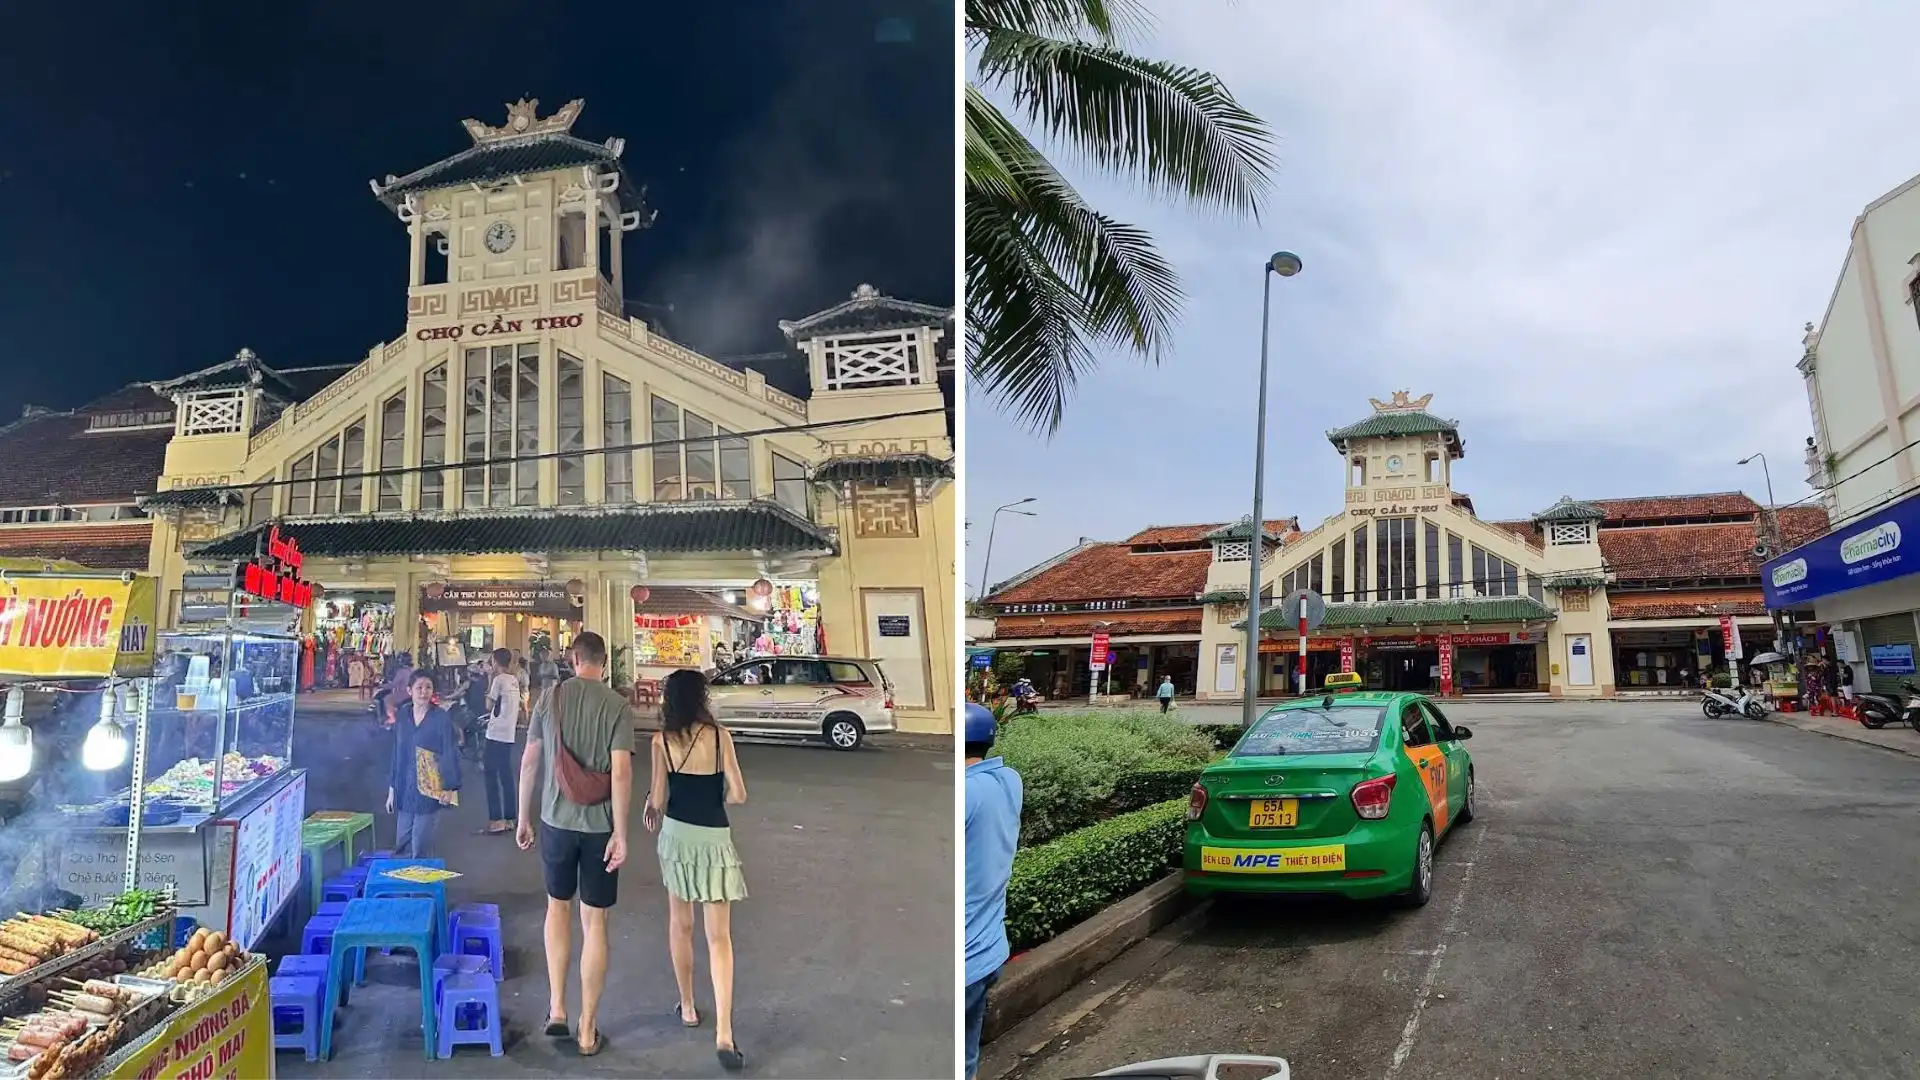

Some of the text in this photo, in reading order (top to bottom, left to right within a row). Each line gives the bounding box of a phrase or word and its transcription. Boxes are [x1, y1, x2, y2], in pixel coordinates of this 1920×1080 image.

[416, 313, 584, 342] CHỢ CẦN THƠ
[0, 586, 113, 648] Ì NƯỚNG
[1263, 799, 1284, 812] 65A
[1254, 813, 1292, 825] 075.13
[1233, 854, 1282, 868] MPE
